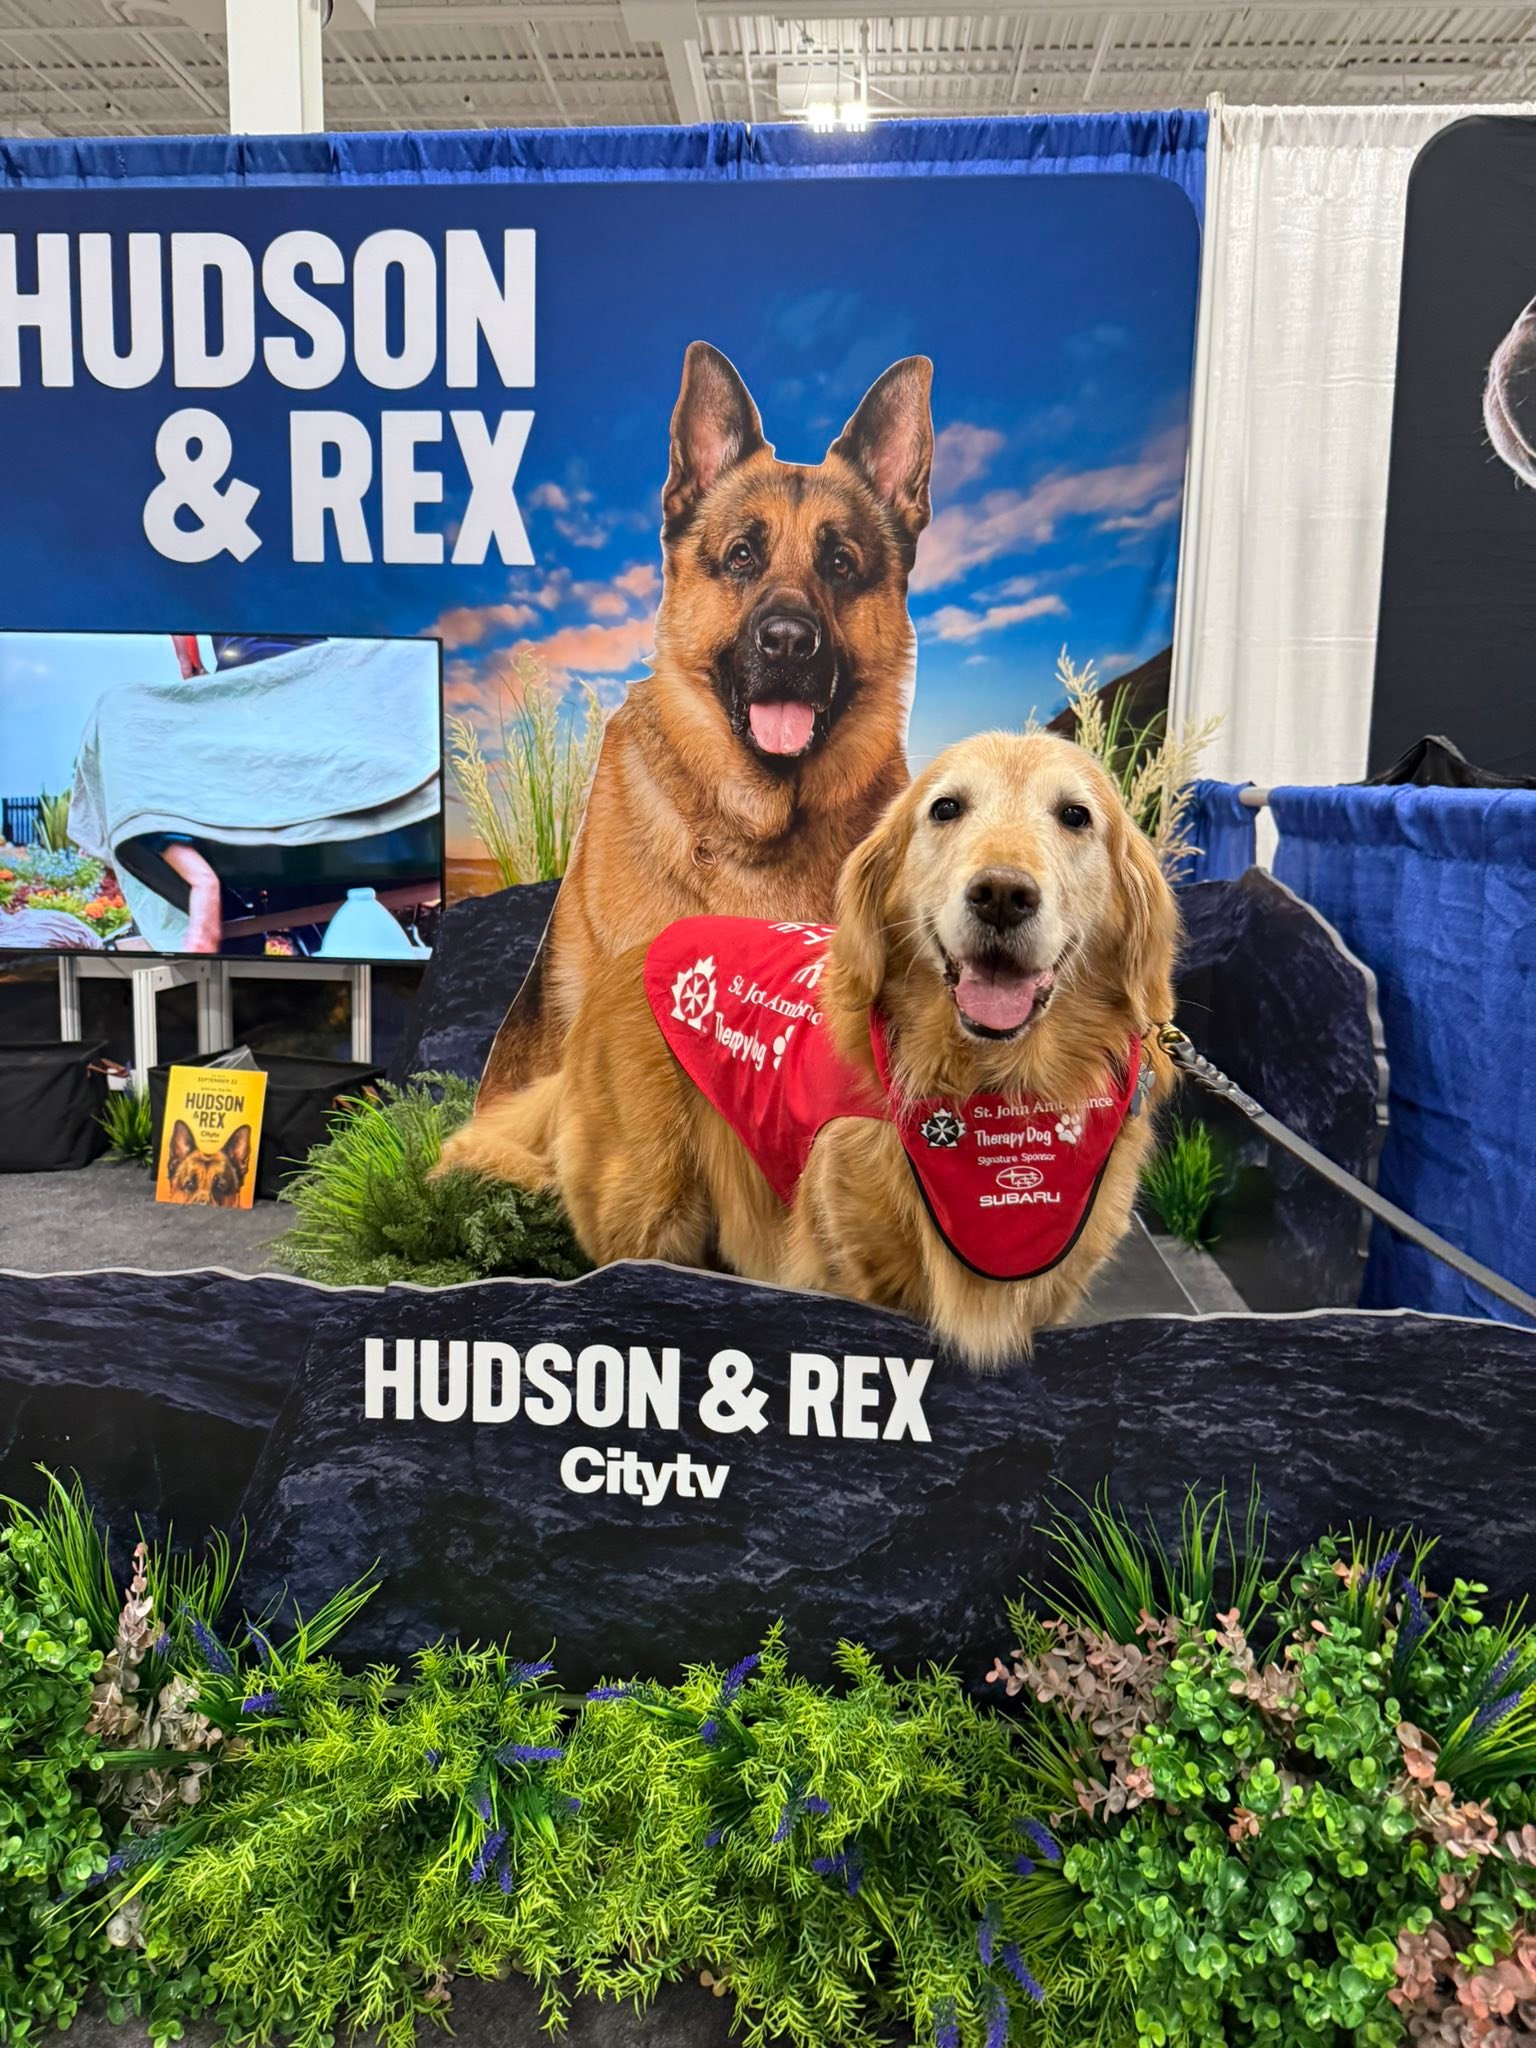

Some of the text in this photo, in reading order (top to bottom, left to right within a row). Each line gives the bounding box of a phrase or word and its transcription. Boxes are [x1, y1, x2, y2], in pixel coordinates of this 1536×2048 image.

[0, 229, 536, 390] HUDSON
[143, 408, 535, 566] & REX
[185, 1092, 245, 1112] HUDSON
[974, 1106, 993, 1119] St.
[995, 1104, 1029, 1119] John
[199, 1111, 226, 1128] REX
[974, 1126, 1052, 1148] Therapy Dog
[977, 1152, 1056, 1167] Signature Sponsor
[979, 1191, 1061, 1207] SUBARU
[364, 1338, 934, 1442] HUDSON & REX
[560, 1446, 730, 1506] Citytv
